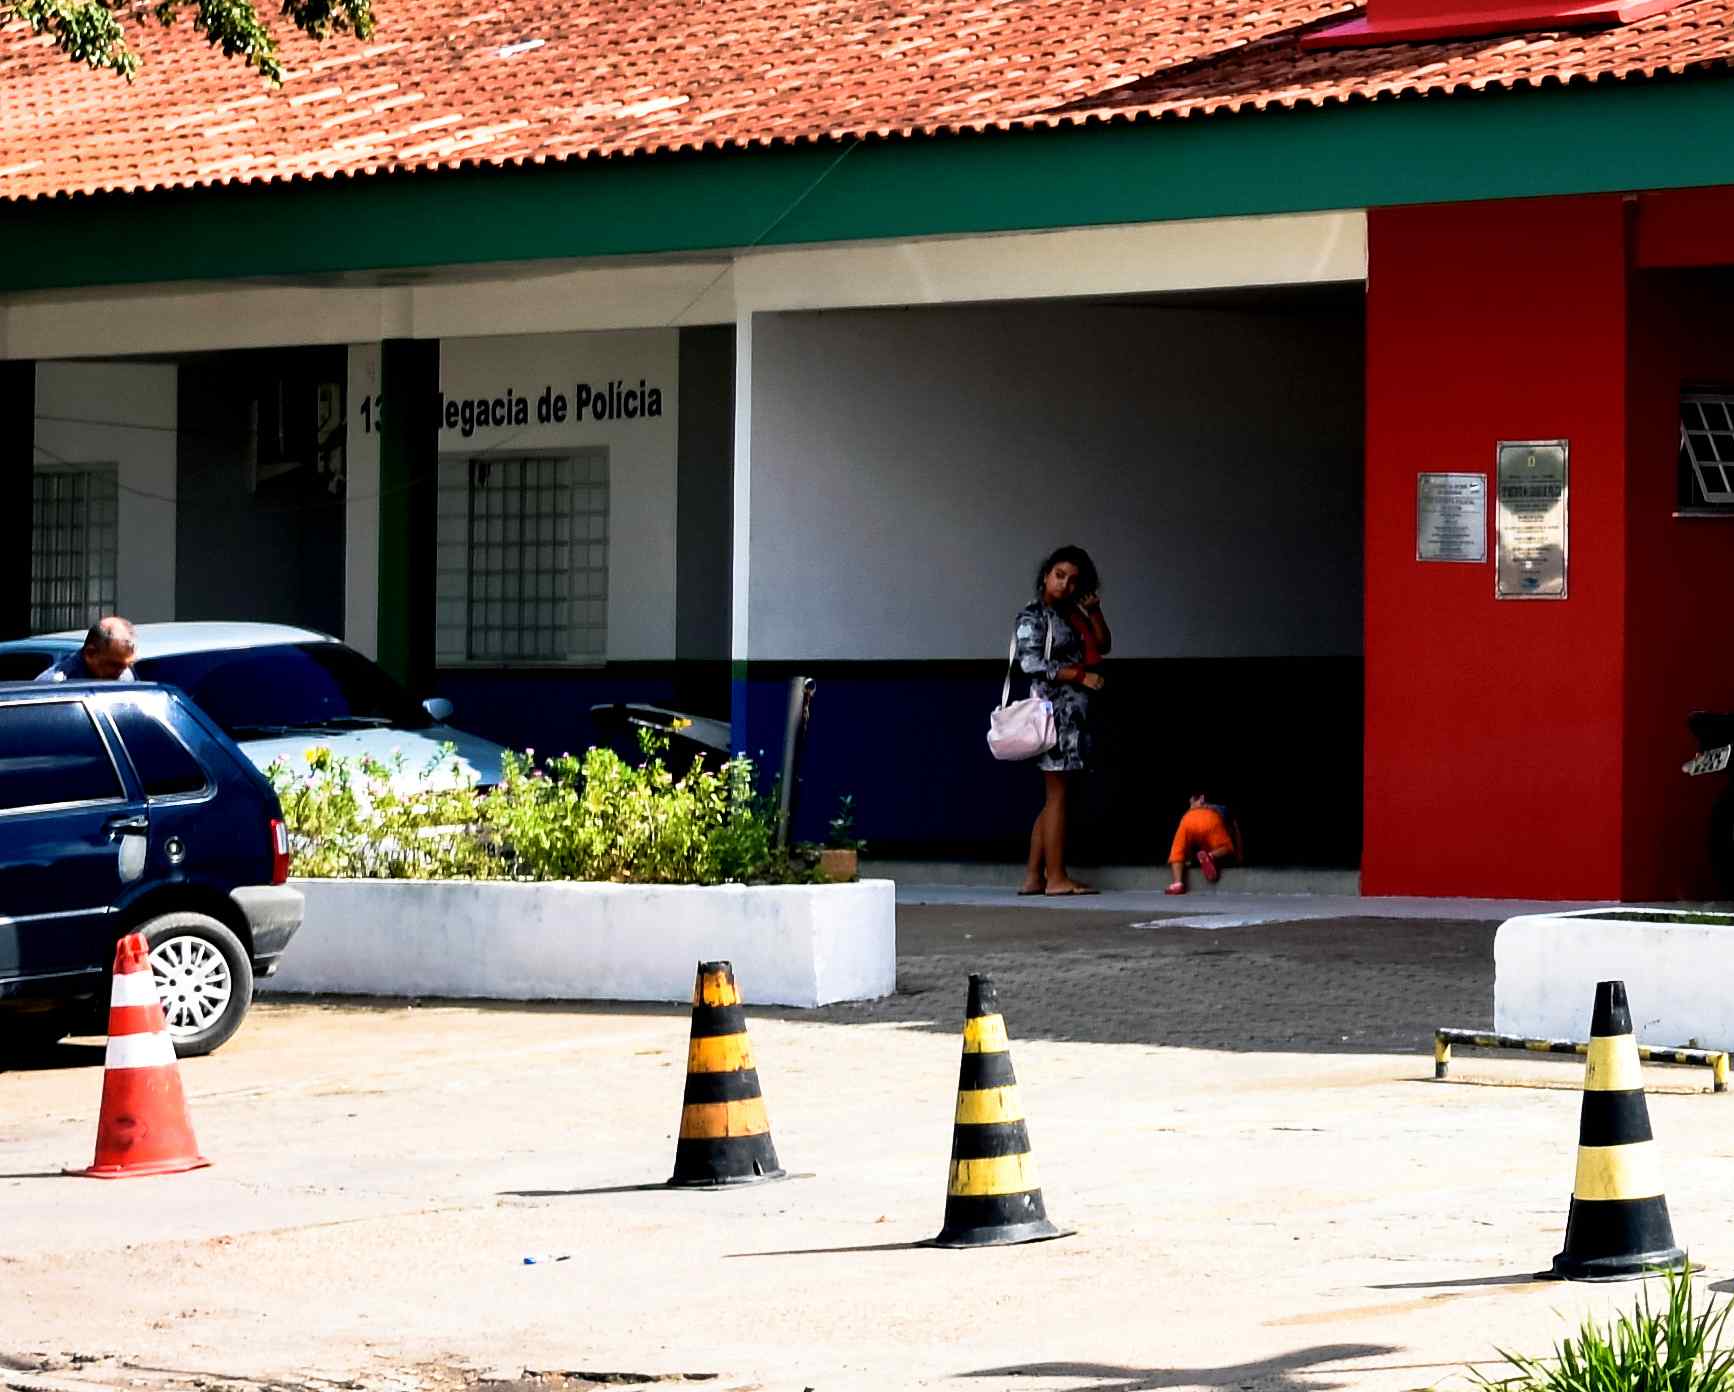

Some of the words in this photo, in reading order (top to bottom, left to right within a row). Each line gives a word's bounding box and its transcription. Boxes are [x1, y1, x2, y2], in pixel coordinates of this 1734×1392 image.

[437, 388, 529, 437] legacia
[536, 385, 568, 423] de
[575, 376, 663, 422] Polícia
